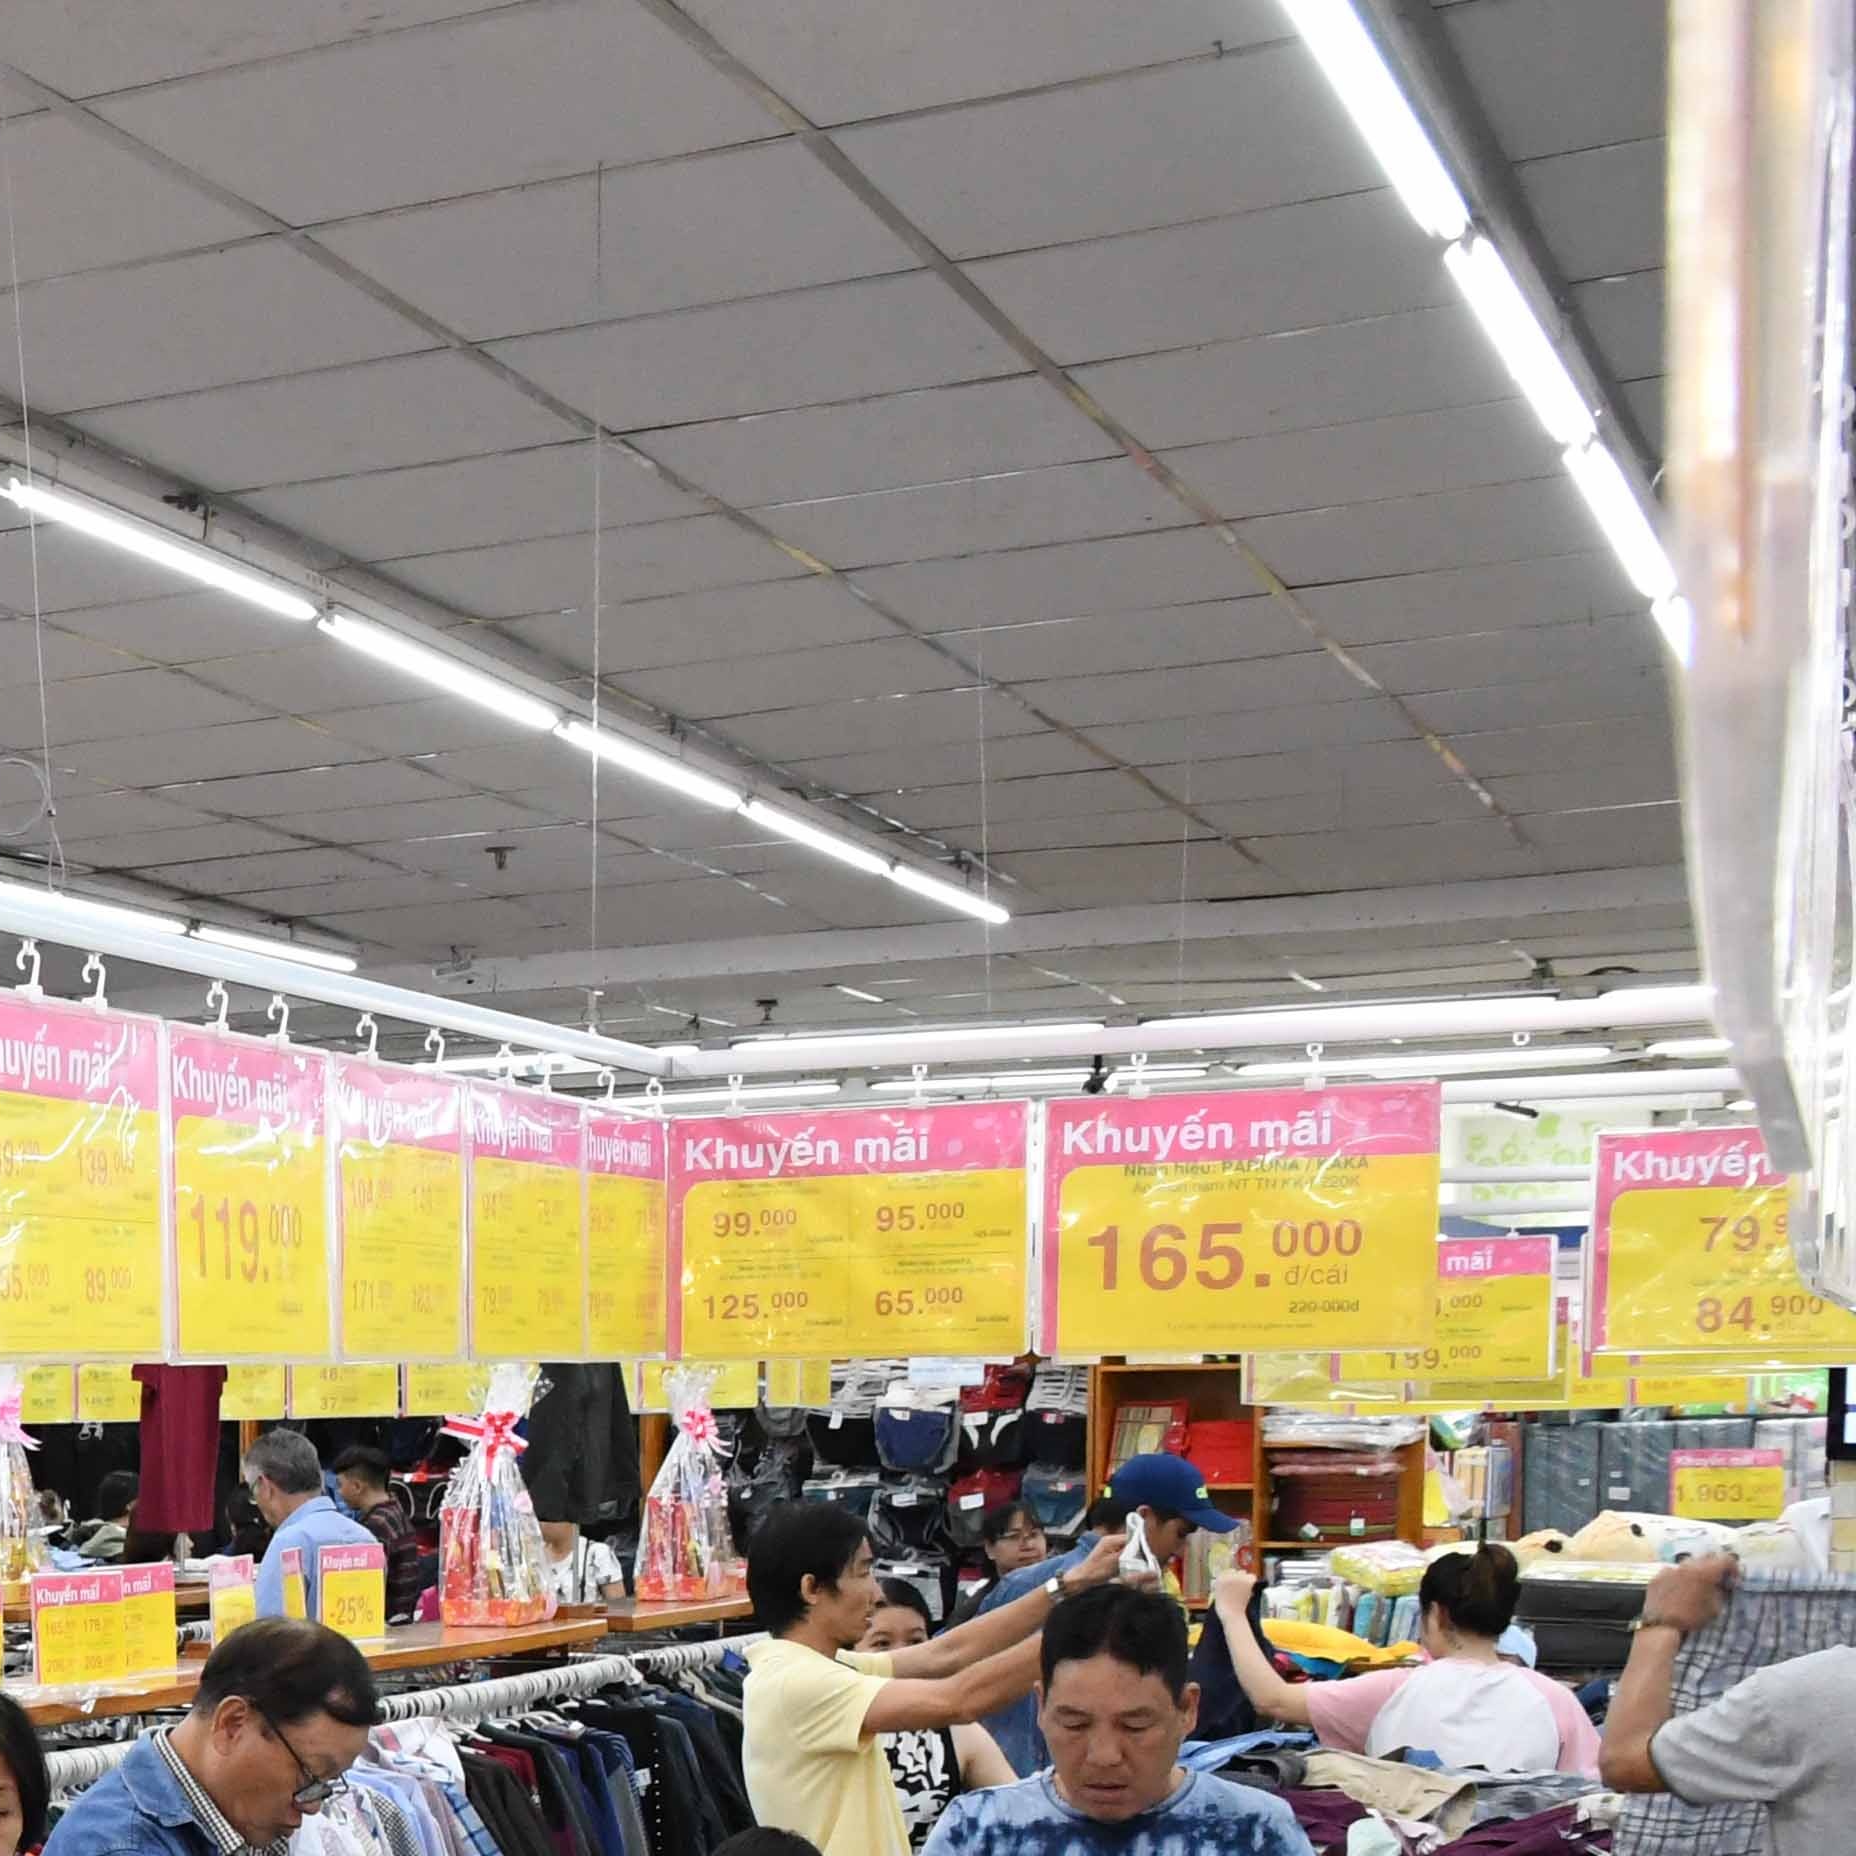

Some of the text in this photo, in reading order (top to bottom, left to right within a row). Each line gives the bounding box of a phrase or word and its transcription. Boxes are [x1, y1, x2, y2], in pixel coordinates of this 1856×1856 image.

[69, 1038, 111, 1090] mãi
[173, 1055, 250, 1115] Khuyến
[686, 1125, 929, 1177] Khuyến mãi
[1062, 1108, 1334, 1161] Khuyến mãi
